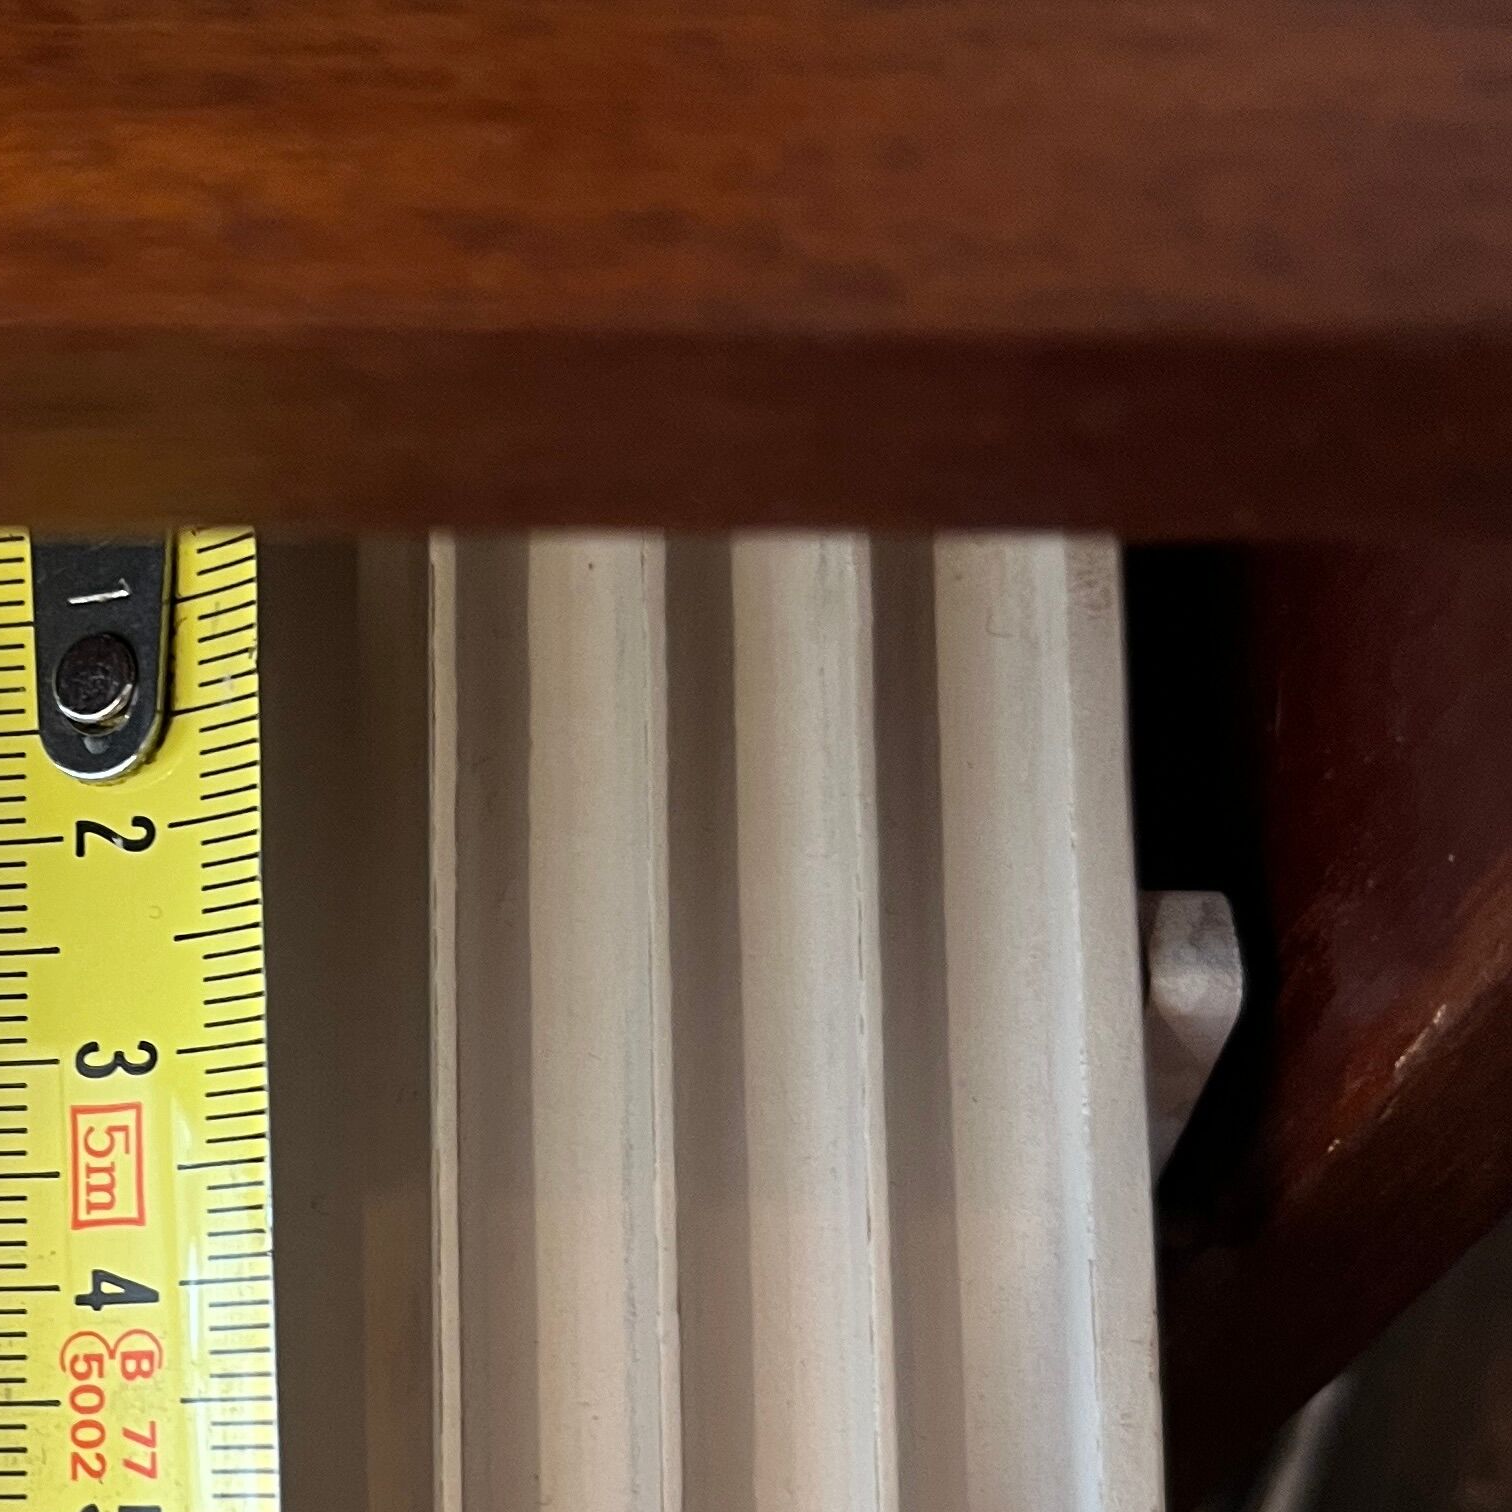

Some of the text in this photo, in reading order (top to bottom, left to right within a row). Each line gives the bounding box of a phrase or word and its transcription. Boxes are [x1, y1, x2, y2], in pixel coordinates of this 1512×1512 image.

[74, 815, 157, 858] 2
[74, 1041, 158, 1079] 3
[83, 1124, 130, 1215] 5m
[74, 1268, 160, 1311] 4
[67, 1352, 108, 1482] 5002
[120, 1349, 158, 1481] B 77
